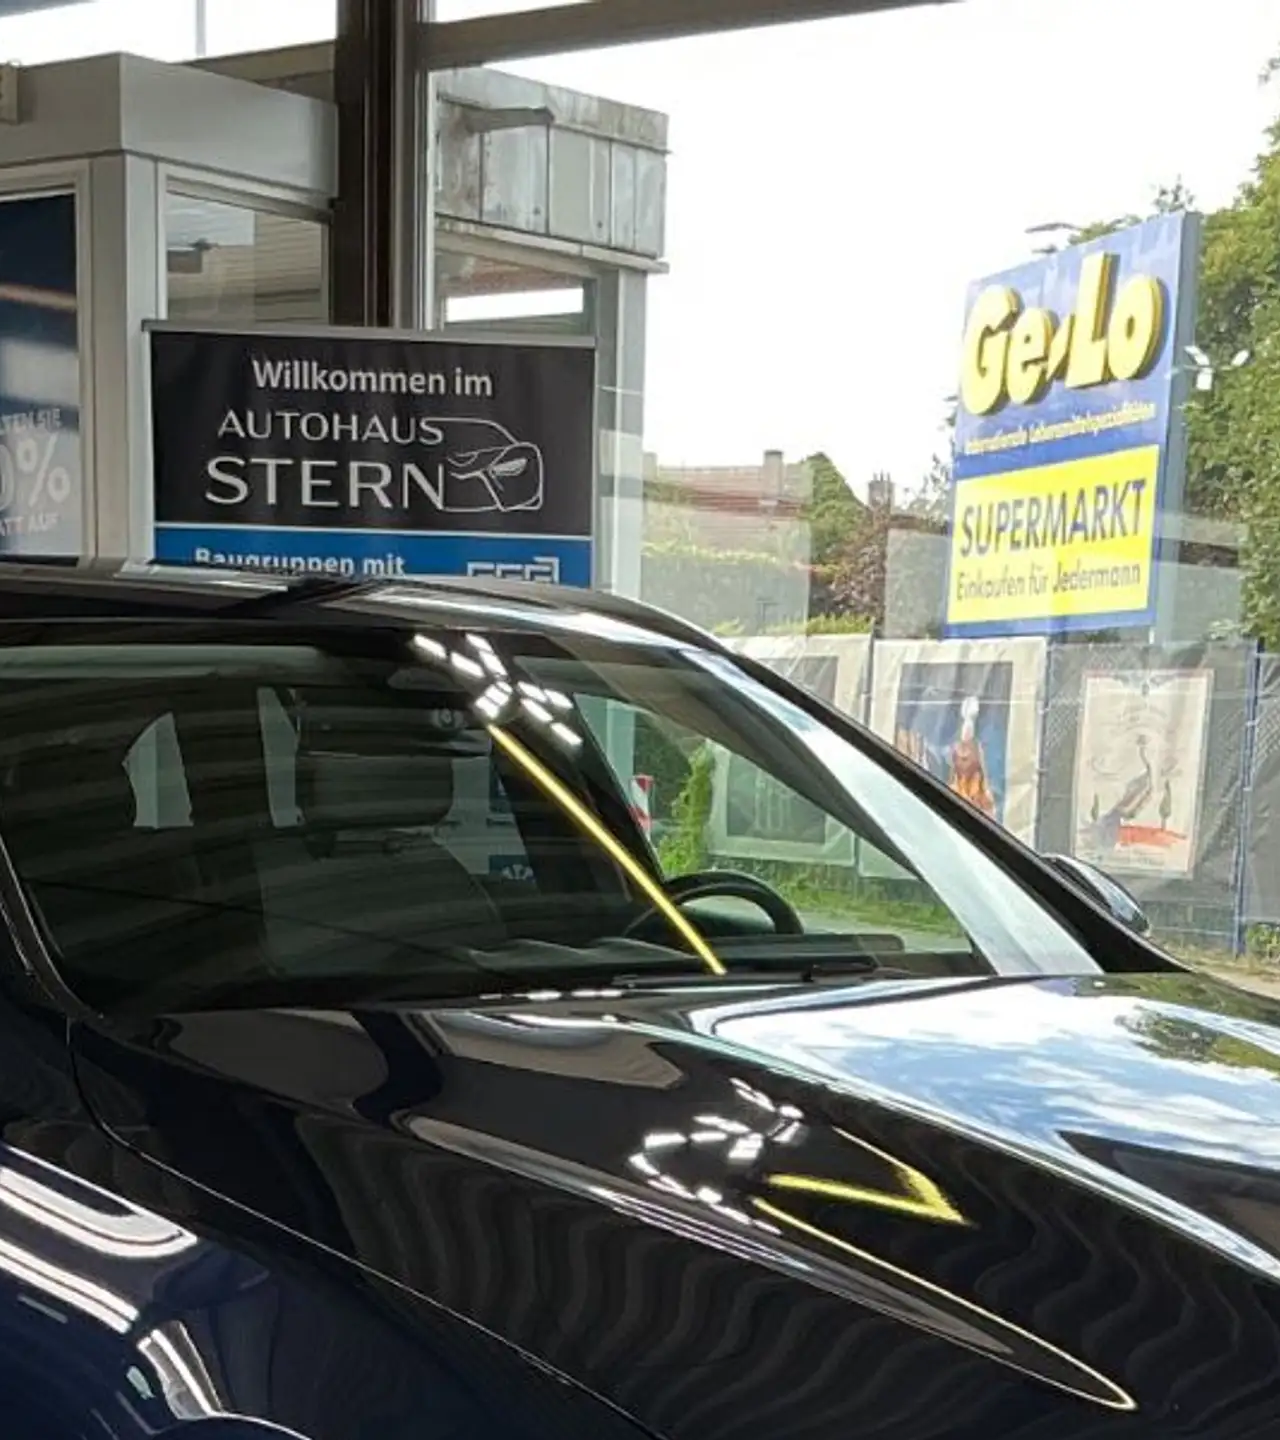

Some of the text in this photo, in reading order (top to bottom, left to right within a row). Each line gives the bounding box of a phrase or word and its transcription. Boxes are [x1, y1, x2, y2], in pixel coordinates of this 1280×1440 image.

[252, 358, 494, 396] Willkommen im
[218, 409, 444, 445] AUTOHAUS
[204, 456, 446, 511] STERN
[960, 478, 1146, 558] SUPERMARKT
[362, 553, 406, 577] mit
[955, 557, 1141, 601] Einkaufen für Jedermann
